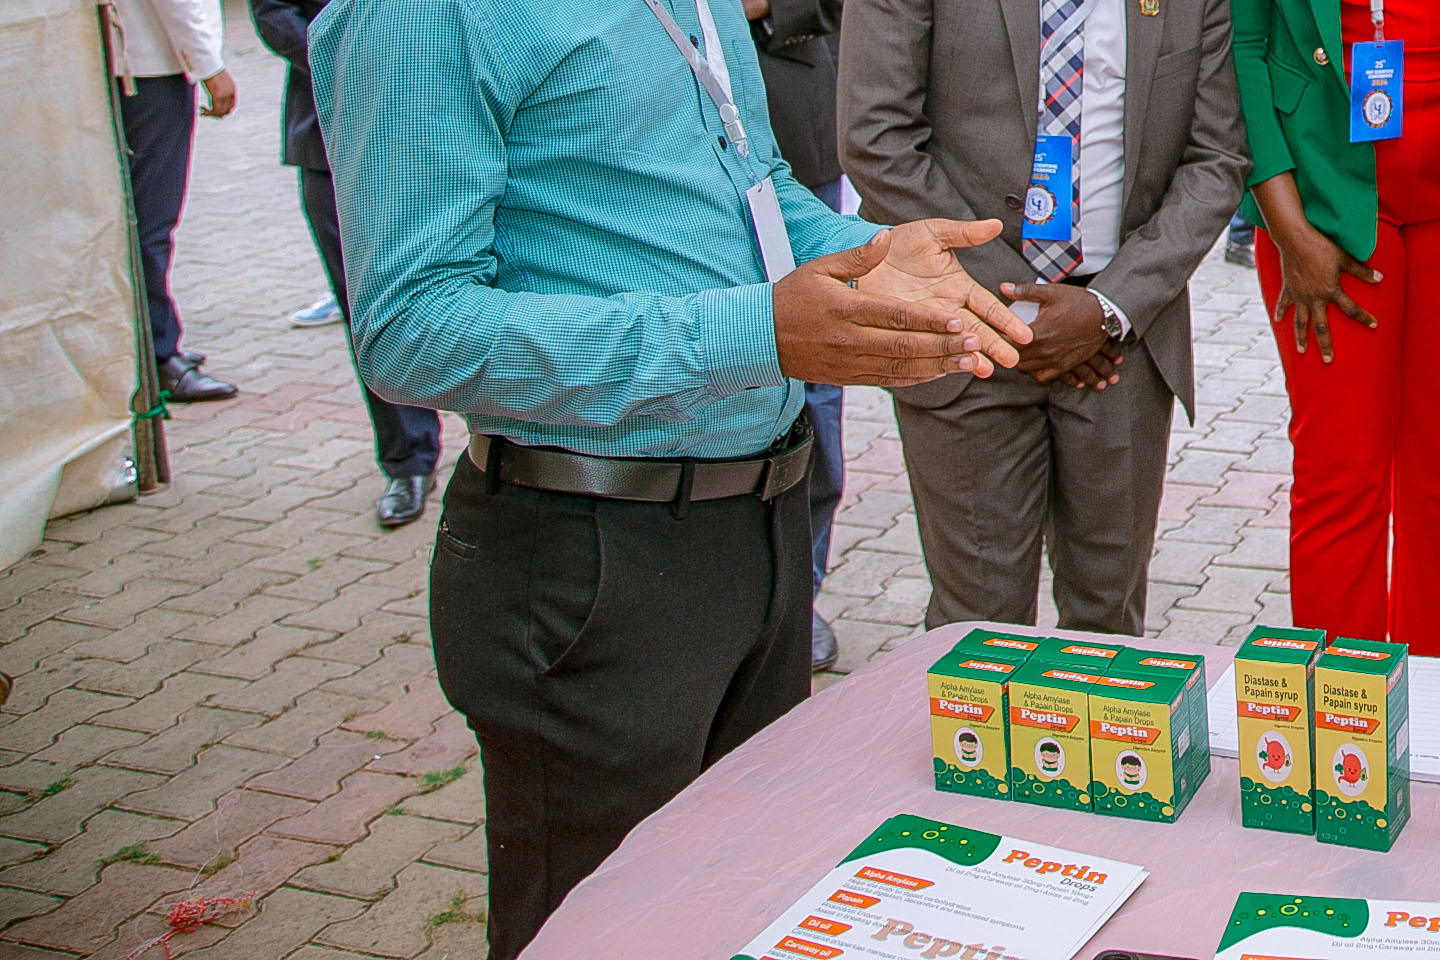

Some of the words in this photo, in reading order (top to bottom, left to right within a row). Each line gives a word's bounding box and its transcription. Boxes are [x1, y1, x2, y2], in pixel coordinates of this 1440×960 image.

[1264, 640, 1305, 649] Peptin
[1071, 647, 1107, 657] Peptin
[1337, 648, 1379, 657] Peptin
[1149, 660, 1185, 669] Peptin
[1052, 671, 1088, 682] Peptin
[1109, 677, 1145, 686] Peptin
[1244, 674, 1279, 687] Diastase
[1281, 678, 1287, 688] &
[941, 682, 958, 691] Alpha
[1323, 684, 1358, 698] Diastase
[1361, 689, 1367, 699] &
[970, 695, 989, 704] Drops
[1024, 691, 1042, 701] Alpha
[1043, 694, 1071, 705] Amylase
[1245, 686, 1272, 700] Papain
[1275, 690, 1298, 702] syrup
[938, 699, 983, 715] Peptin
[1030, 701, 1053, 711] Papain
[1054, 704, 1073, 714] Drops
[1103, 705, 1122, 715] Alpha
[1122, 707, 1151, 718] Amylase
[1247, 702, 1290, 715] Peptin
[1323, 696, 1351, 709] Papain
[1354, 701, 1377, 715] syrup
[1020, 709, 1067, 725] Peptin
[1111, 714, 1133, 724] Papain
[1134, 717, 1154, 726] Drops
[1325, 714, 1368, 728] Peptin
[1101, 723, 1148, 738] Peptin
[1002, 849, 1108, 885] Peptin
[862, 870, 886, 880] Alpha
[886, 875, 918, 887] Amylase
[1060, 877, 1098, 892] Drops
[837, 894, 864, 905] Papain
[807, 919, 820, 928] Dil
[820, 922, 832, 930] oil
[784, 940, 819, 954] Caraway
[820, 949, 832, 957] oil
